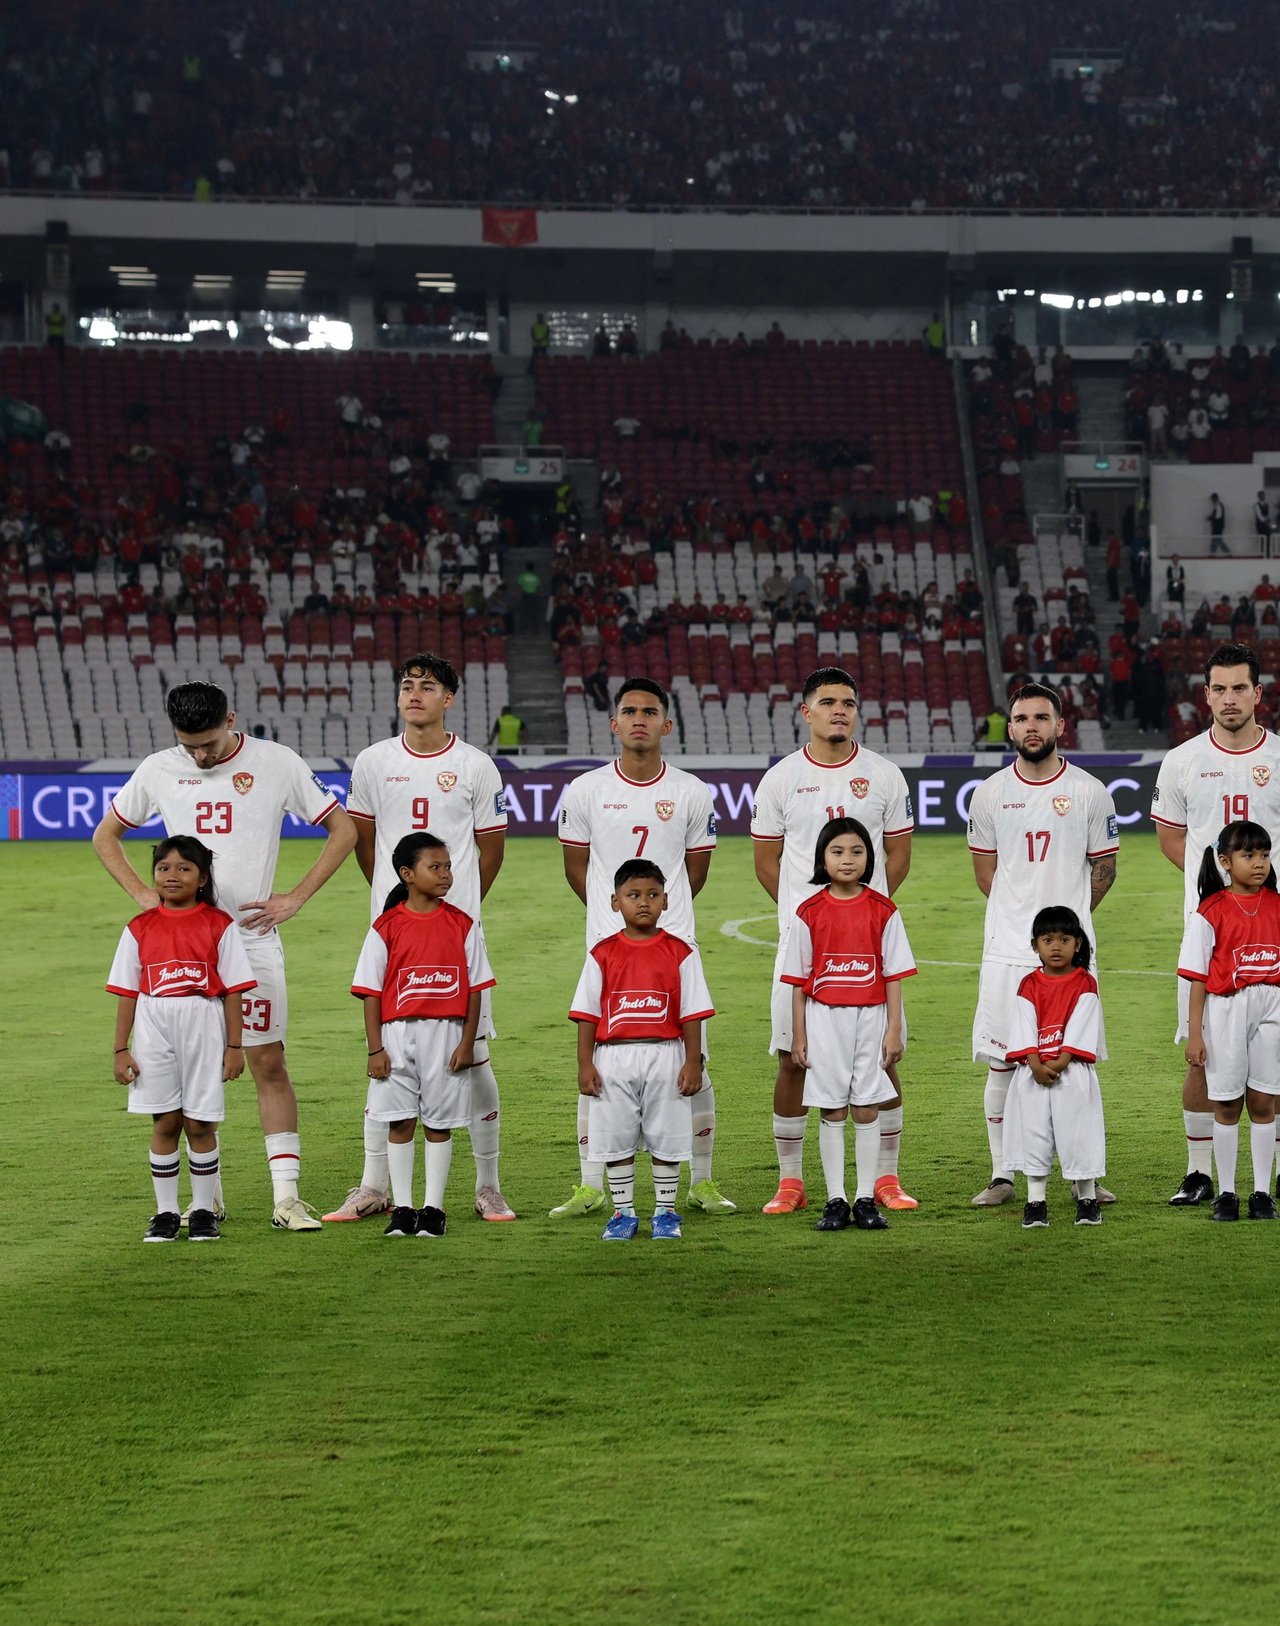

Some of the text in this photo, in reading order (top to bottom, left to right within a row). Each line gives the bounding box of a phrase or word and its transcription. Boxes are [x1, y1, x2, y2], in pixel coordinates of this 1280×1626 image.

[178, 778, 202, 786] erspo
[386, 775, 410, 783] erspo
[1200, 770, 1223, 778] erspo
[797, 785, 820, 794] erspo
[411, 797, 429, 830] 9
[1002, 801, 1026, 810] erspo
[1222, 794, 1248, 825] 19
[196, 801, 233, 834] 23
[632, 826, 649, 858] 7
[1025, 831, 1051, 863] 17
